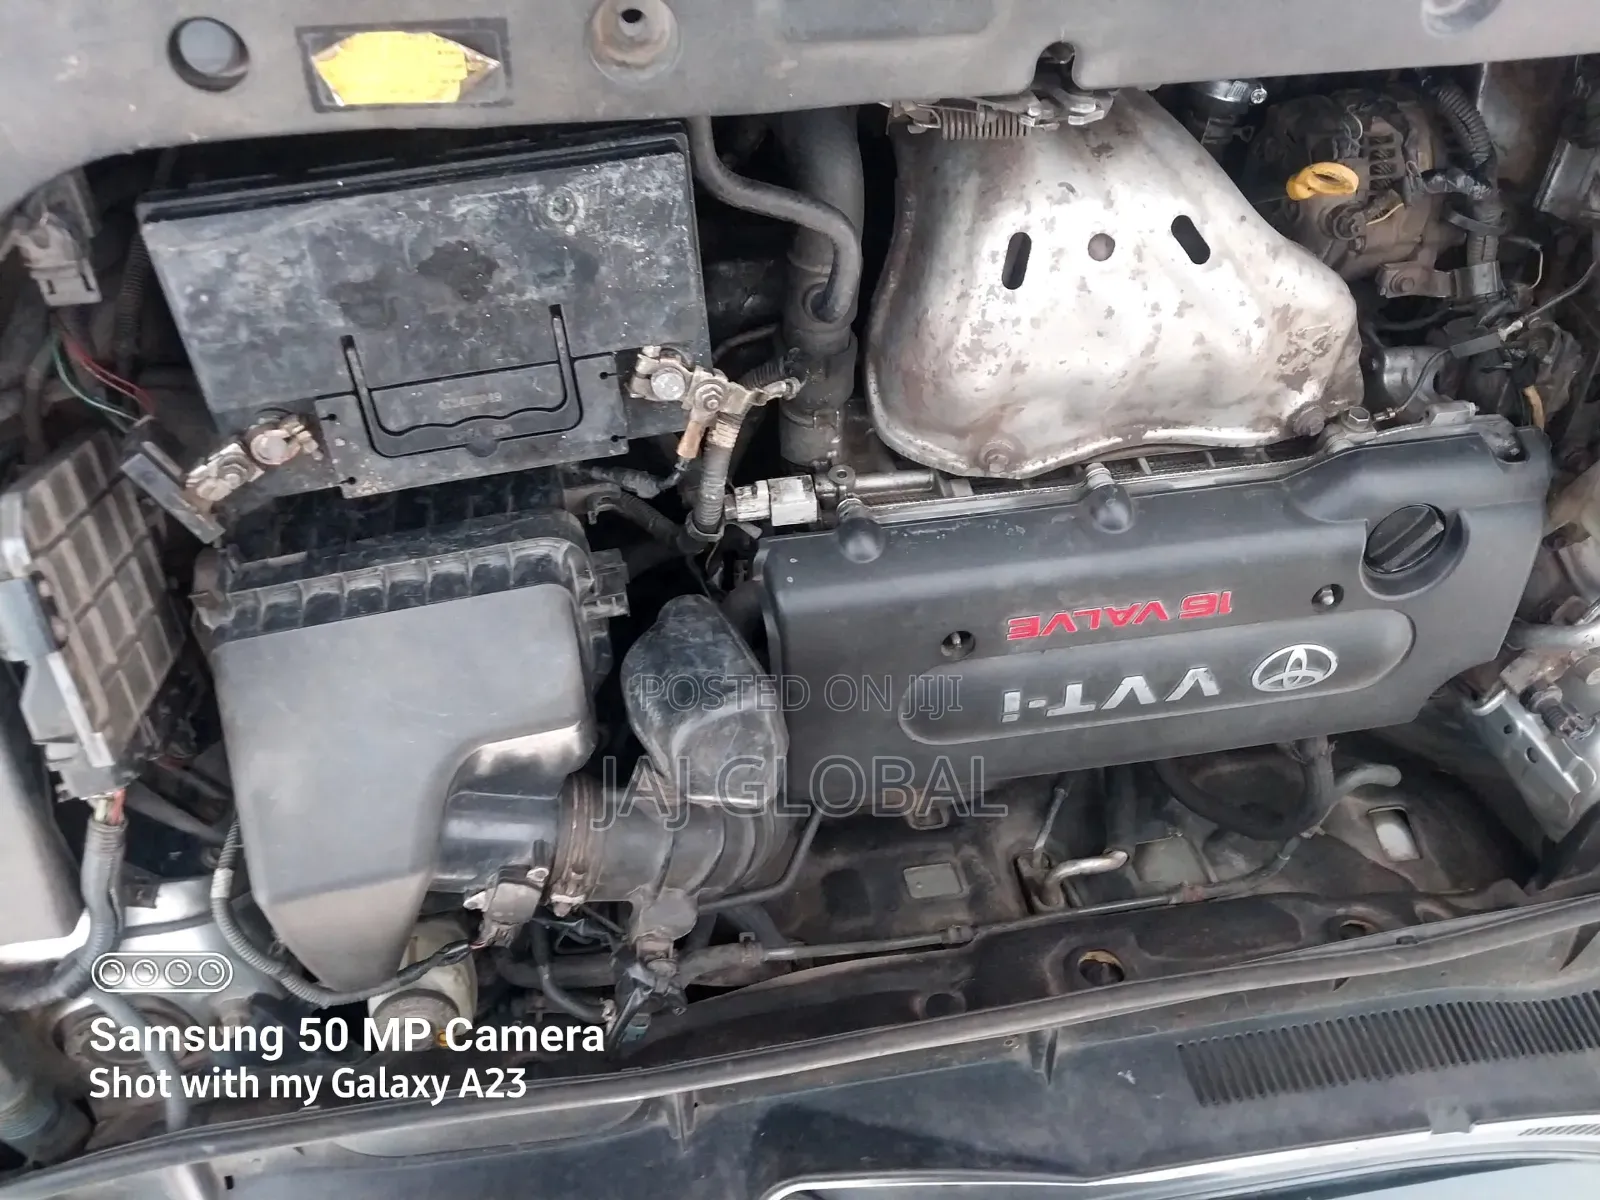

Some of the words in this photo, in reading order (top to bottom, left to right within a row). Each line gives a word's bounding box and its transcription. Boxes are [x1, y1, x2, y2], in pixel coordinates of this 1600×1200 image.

[1006, 600, 1169, 641] VALVE
[1178, 590, 1232, 619] 16
[1001, 666, 1221, 723] VVT-i
